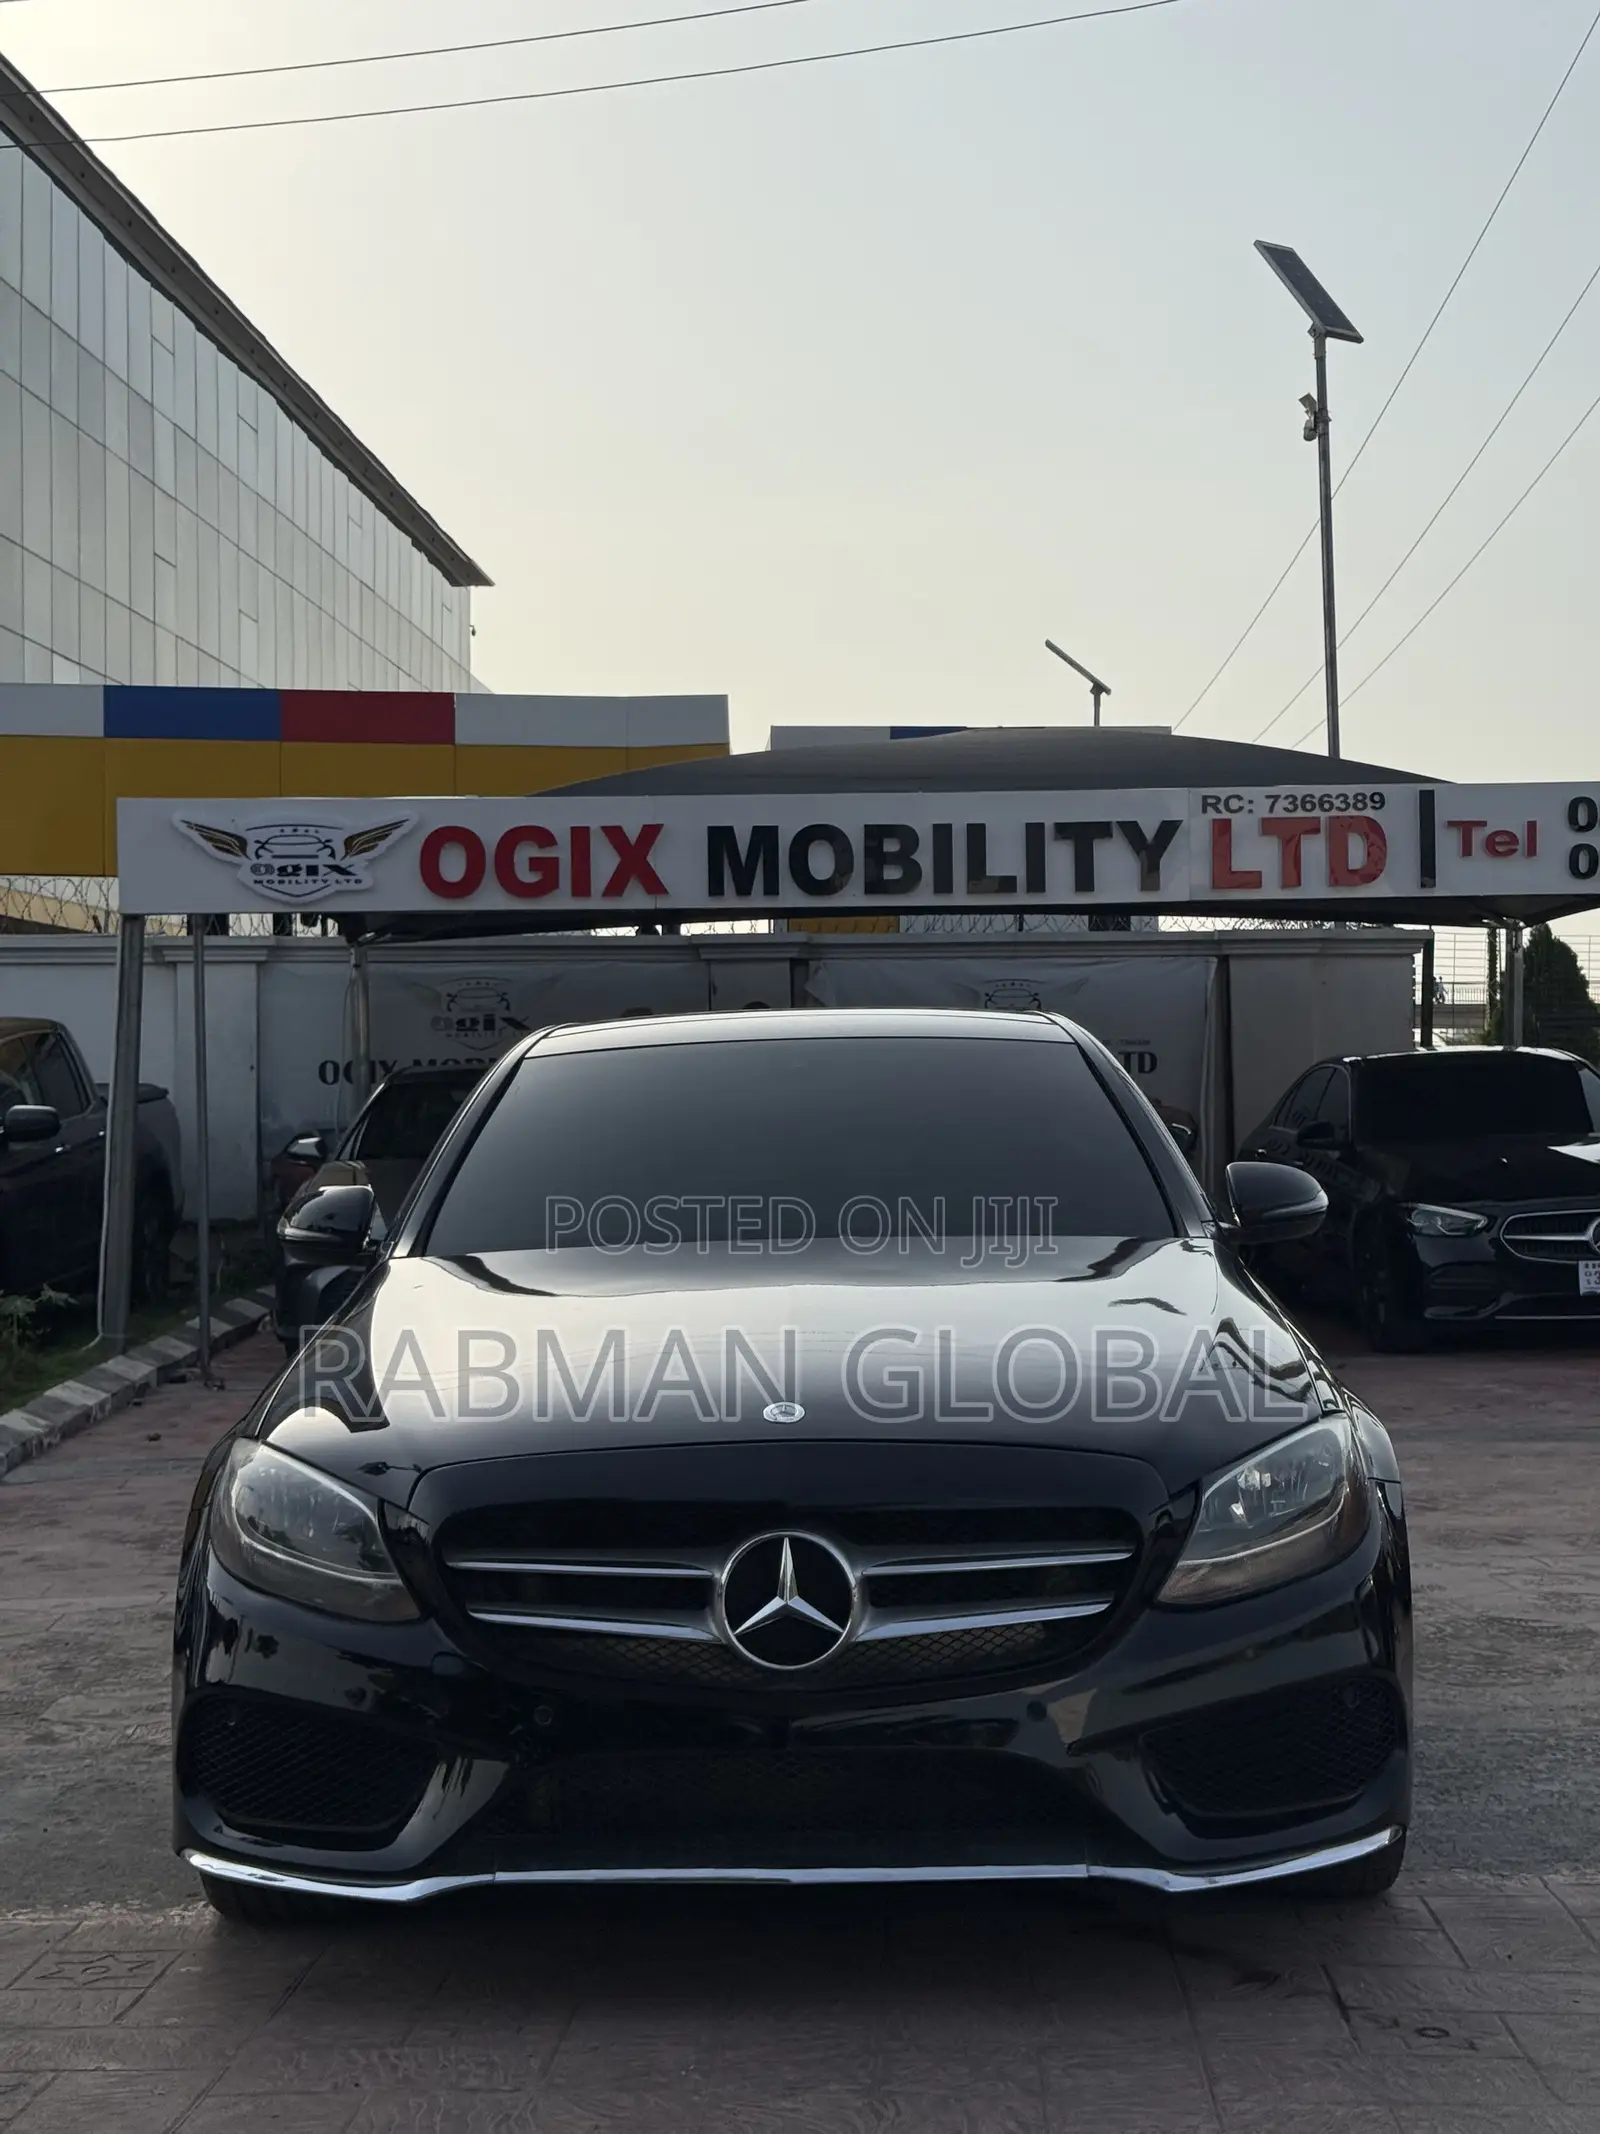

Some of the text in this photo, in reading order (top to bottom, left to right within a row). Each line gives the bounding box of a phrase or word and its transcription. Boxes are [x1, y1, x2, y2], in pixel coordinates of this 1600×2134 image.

[1201, 791, 1386, 814] RC: 7366389
[419, 815, 1388, 899] OGIX MOBILITY LTD
[1447, 820, 1537, 858] Tel
